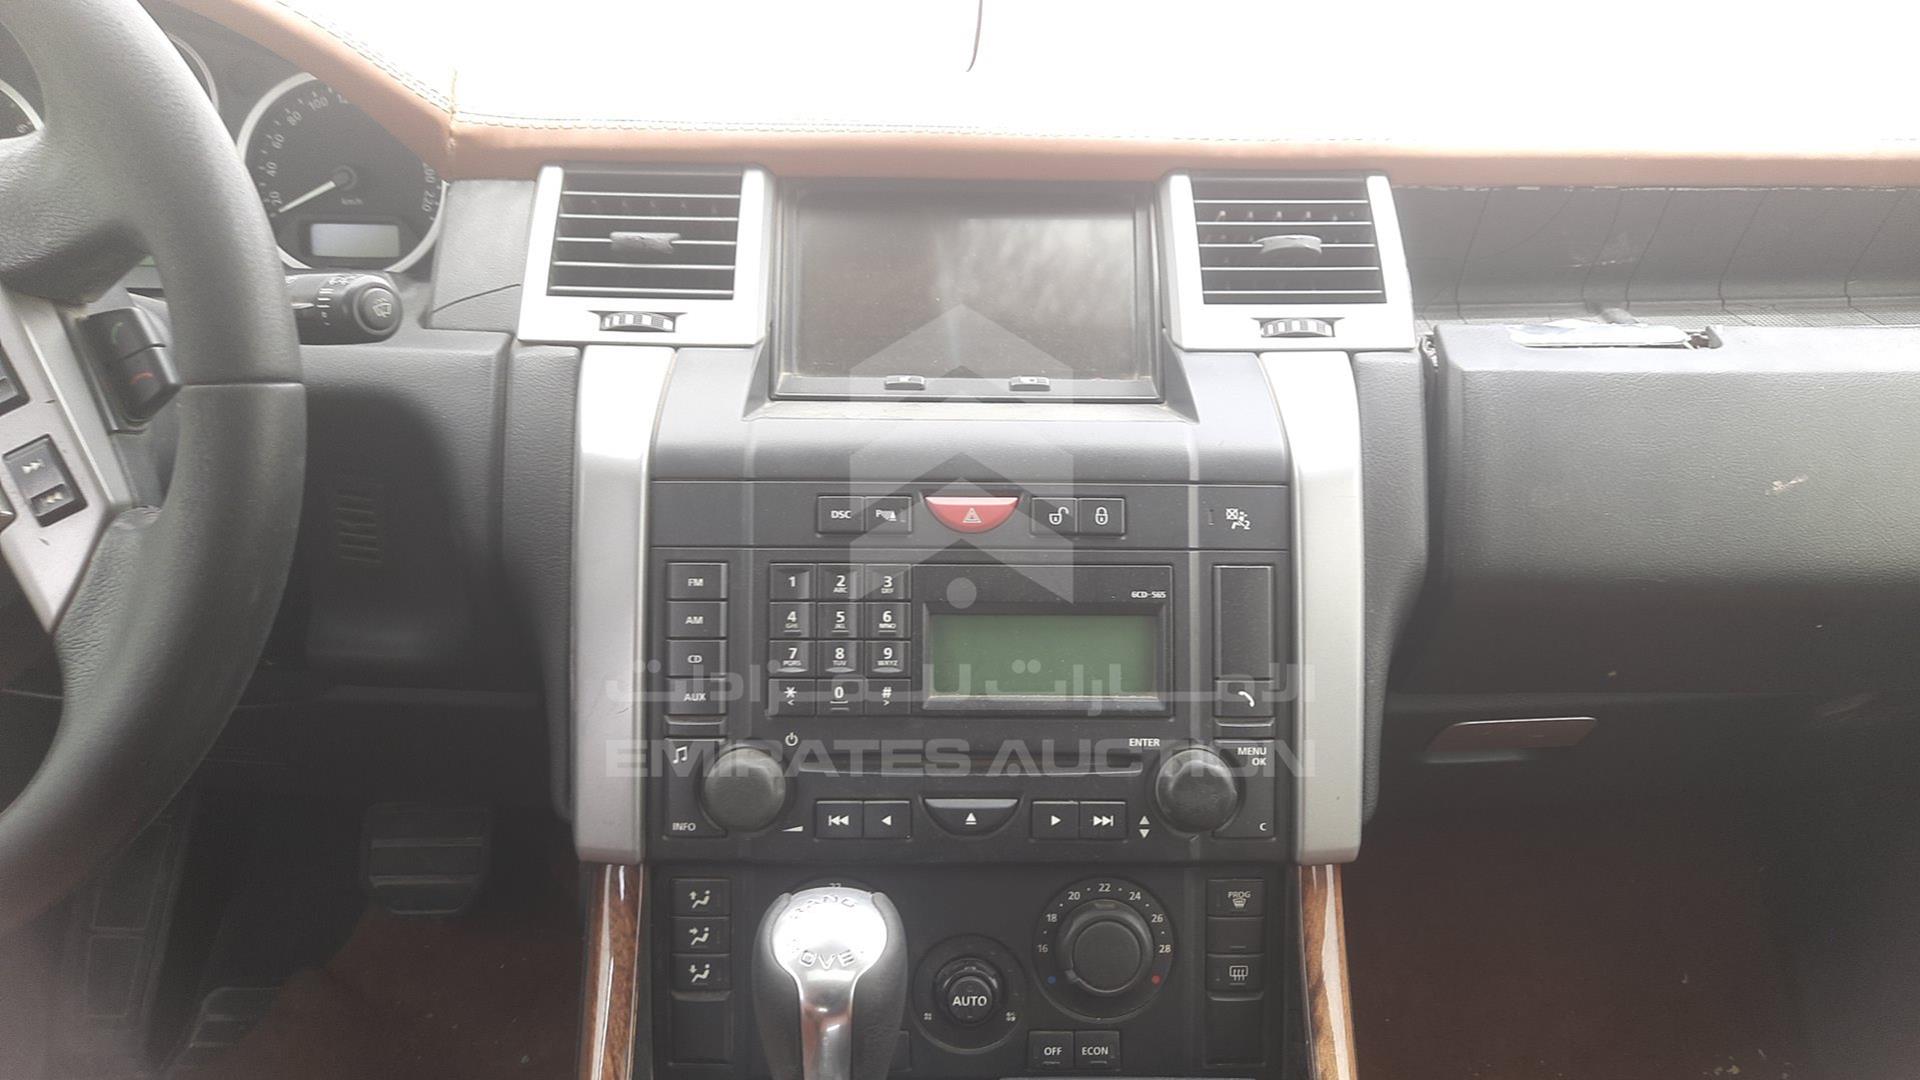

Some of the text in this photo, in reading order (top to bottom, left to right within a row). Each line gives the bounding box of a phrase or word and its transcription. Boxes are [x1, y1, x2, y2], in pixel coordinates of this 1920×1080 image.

[308, 96, 329, 111] 100
[422, 162, 436, 183] 00
[830, 509, 852, 520] DSC
[687, 577, 704, 587] FM
[788, 575, 796, 588] 1
[835, 574, 846, 587] 2
[883, 575, 893, 588] 3
[685, 615, 704, 625] AM
[786, 610, 797, 623] 4
[836, 610, 846, 623] 5
[882, 610, 892, 623] 6
[788, 647, 798, 660] 7
[835, 647, 845, 660] 8
[883, 646, 893, 660] 9
[687, 654, 703, 664] CD
[683, 692, 707, 702] AUX
[834, 686, 844, 700] 0
[1129, 737, 1161, 748] ENTER
[1237, 746, 1268, 757] MENU
[1251, 757, 1268, 767] OK
[671, 821, 697, 832] INFO
[1259, 821, 1267, 832] C
[1098, 883, 1111, 892] 22
[1067, 891, 1081, 900] 20
[1128, 891, 1142, 900] 24
[1227, 890, 1251, 898] PROG
[1046, 913, 1058, 923] 18
[1151, 913, 1164, 923] 26
[1037, 944, 1049, 953] 16
[1158, 944, 1172, 953] 28
[951, 995, 988, 1007] AUTO
[1043, 1046, 1063, 1056] OFF
[1081, 1046, 1109, 1056] ECON
